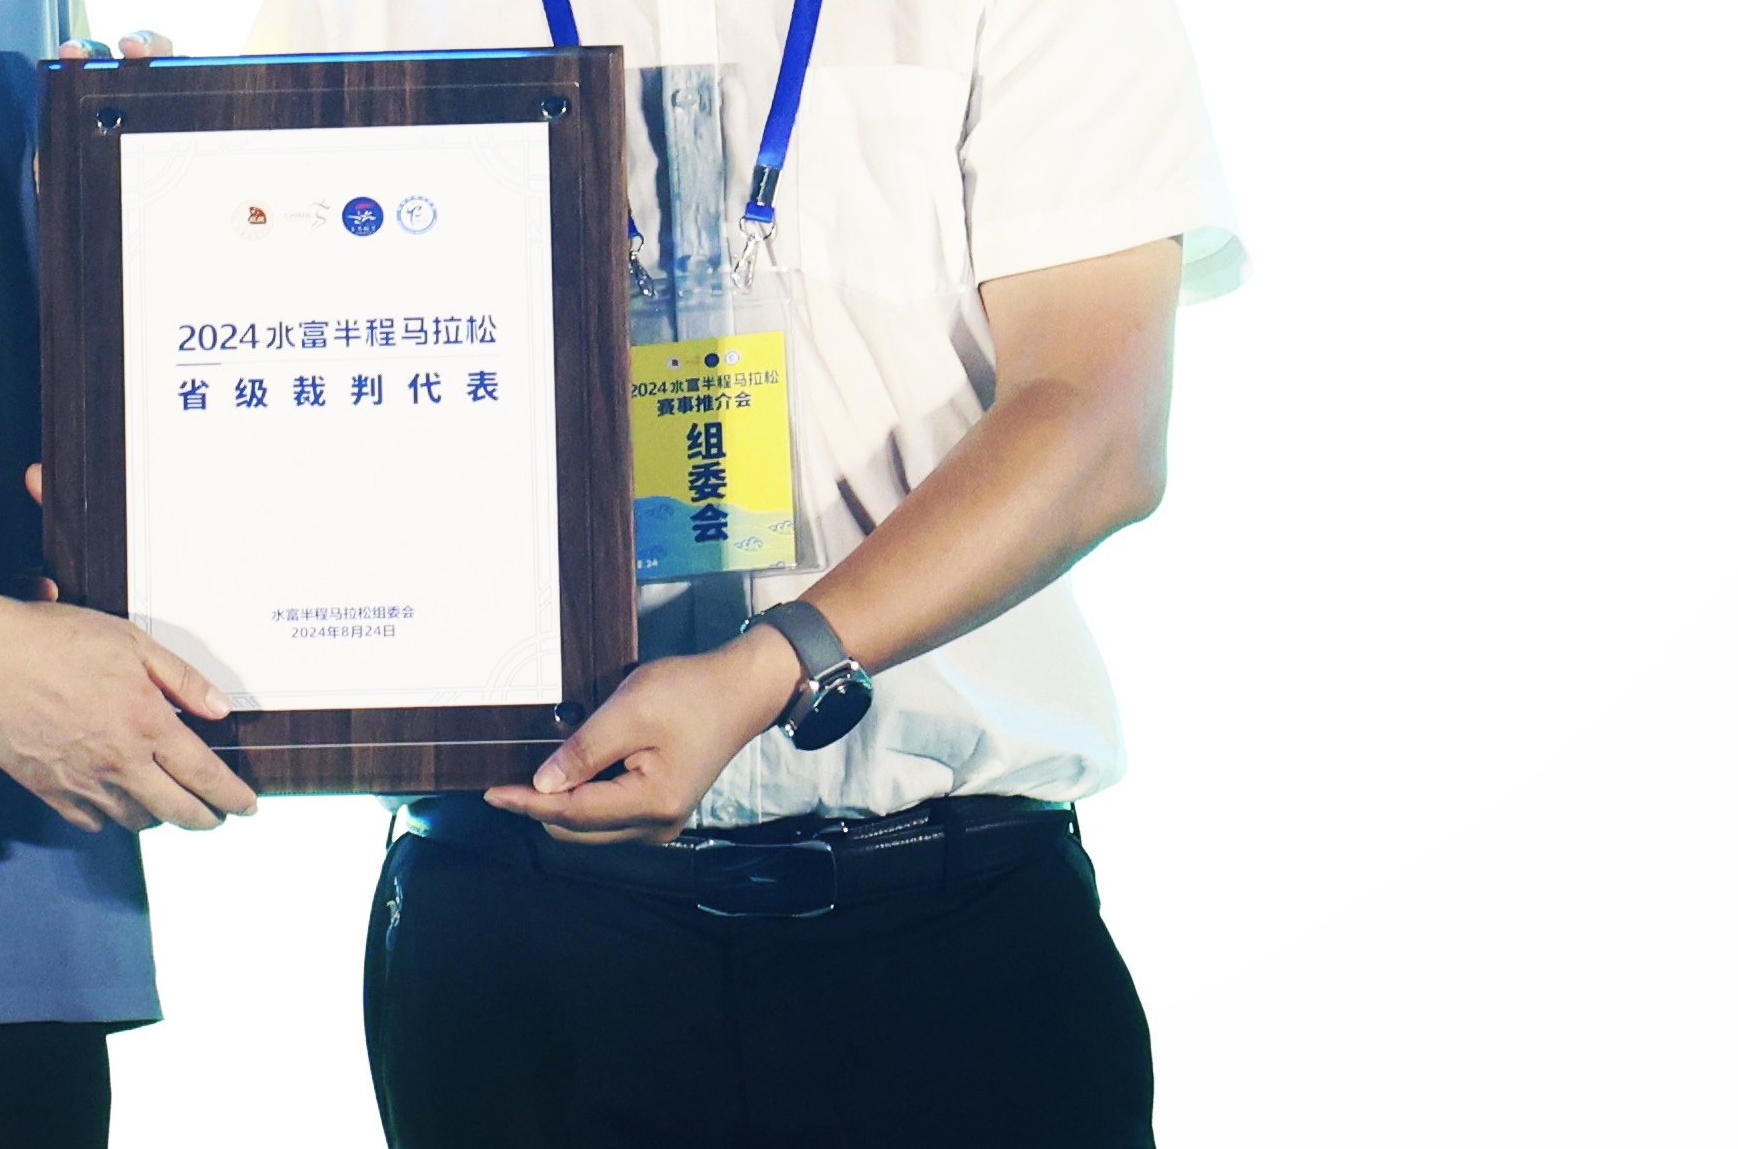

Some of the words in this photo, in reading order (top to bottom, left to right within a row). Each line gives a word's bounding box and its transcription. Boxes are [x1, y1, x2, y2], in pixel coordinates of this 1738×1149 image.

[177, 313, 498, 352] 2024水富半程马拉松
[177, 370, 500, 411] 省级裁判代表
[631, 369, 779, 398] 2024水富半程马拉松
[657, 391, 751, 418] 赛事推介会
[686, 421, 729, 543] 组委会
[271, 605, 415, 622] 水富半程马拉松组委会
[291, 624, 396, 639] 2024年8月24日
